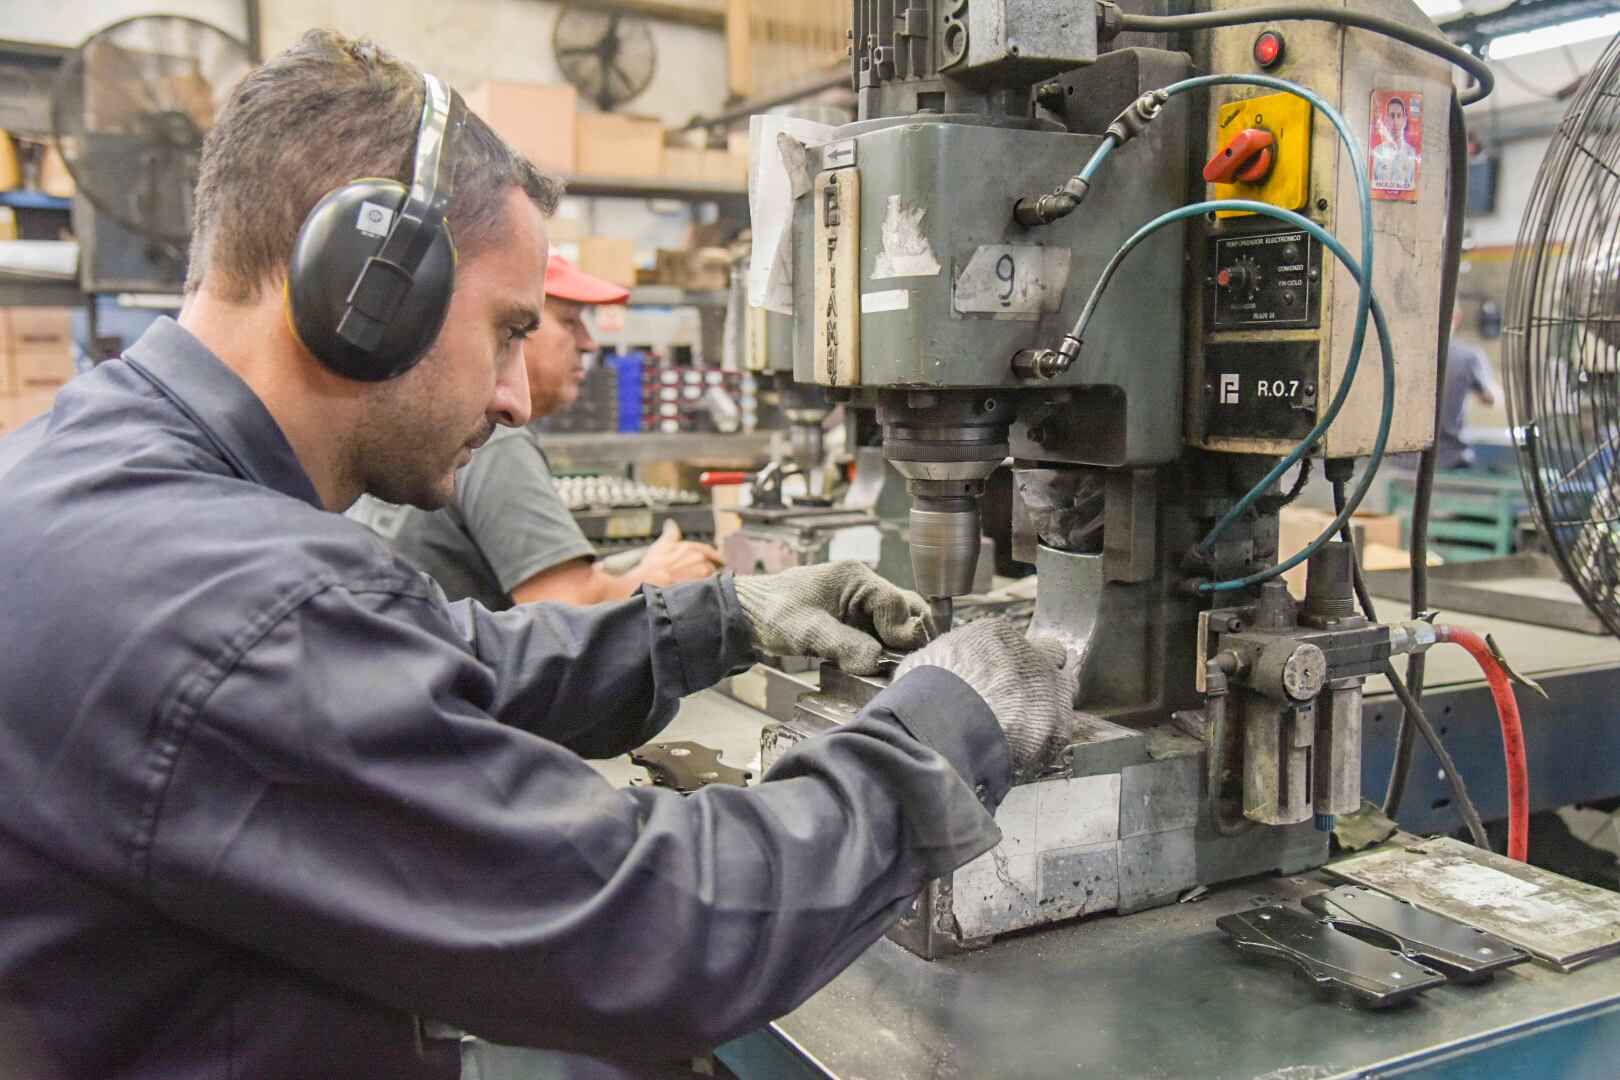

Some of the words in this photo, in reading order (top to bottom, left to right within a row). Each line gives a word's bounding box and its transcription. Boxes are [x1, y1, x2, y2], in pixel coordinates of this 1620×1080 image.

[1226, 238, 1264, 247] TEMPORIZADOR
[1265, 235, 1301, 244] ELECTRONICO
[996, 254, 1014, 300] 9
[1258, 380, 1298, 396] R.O.7
